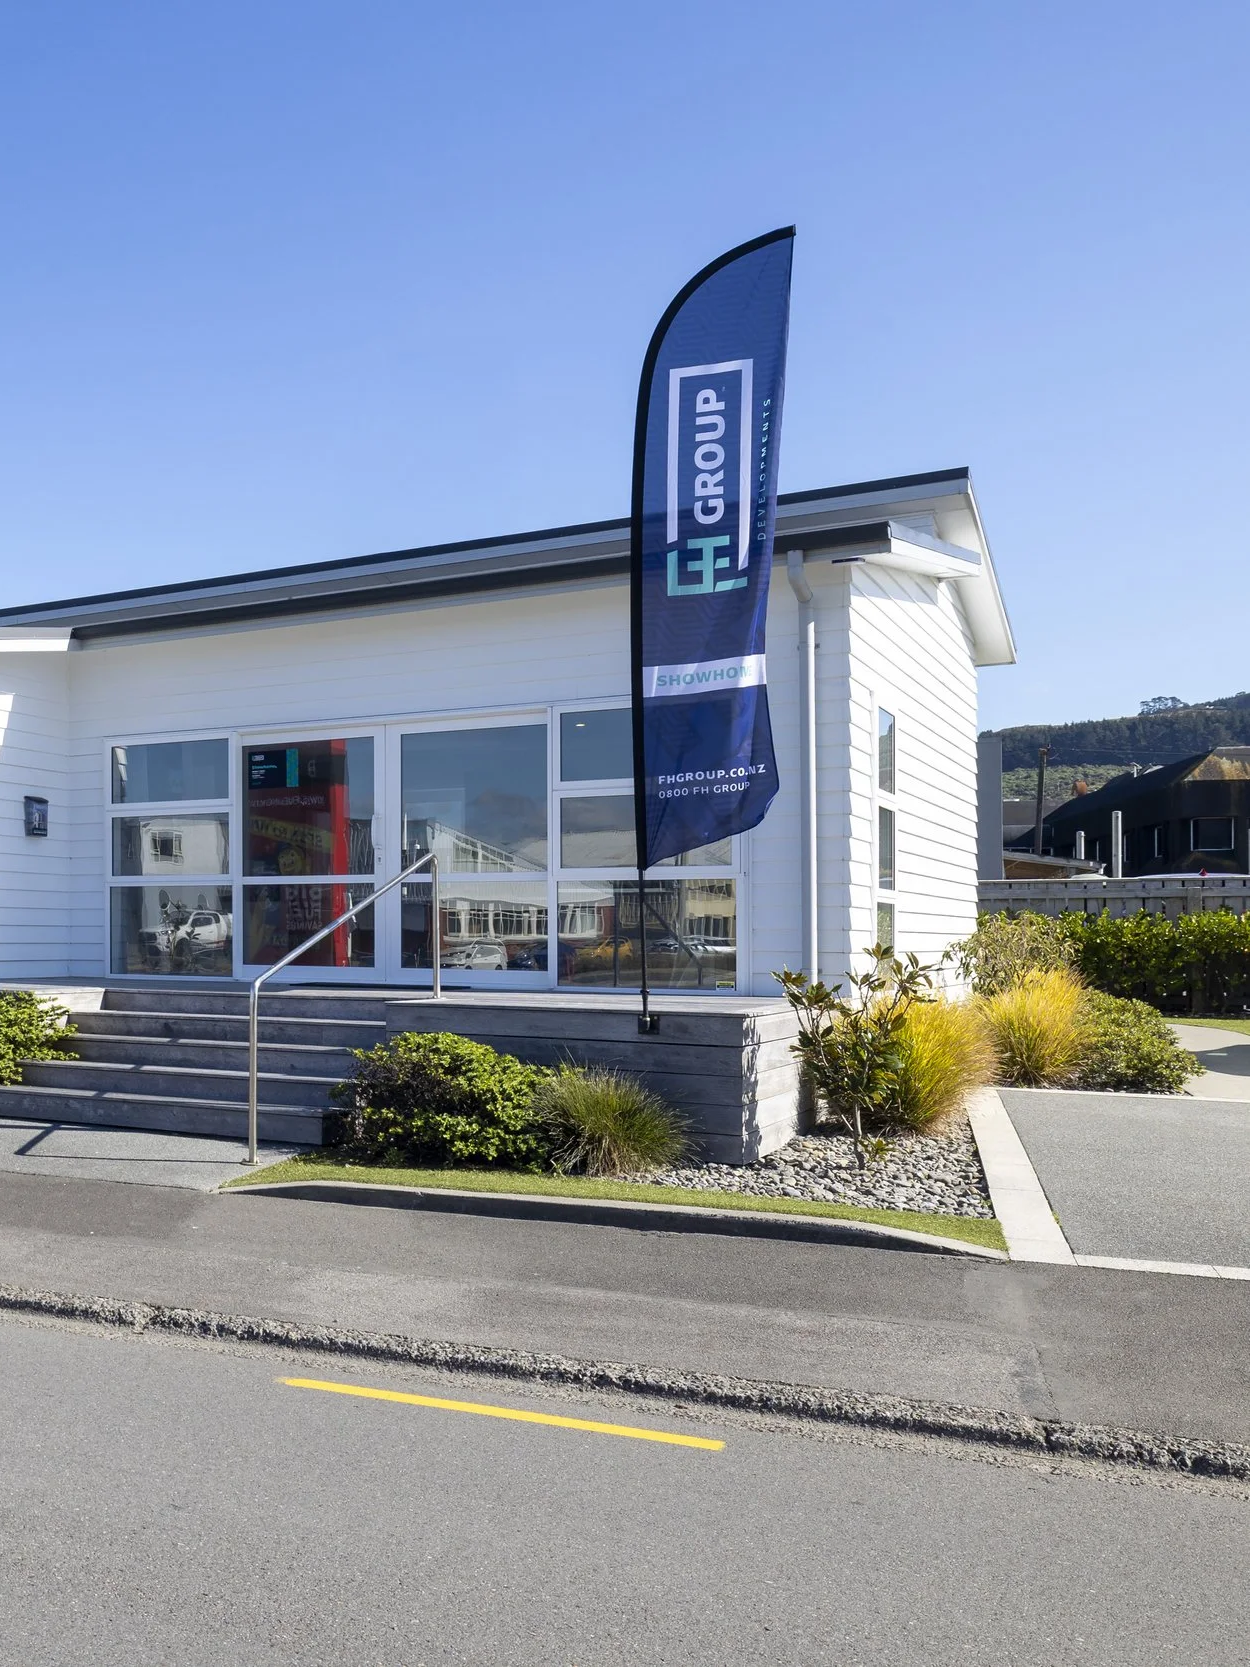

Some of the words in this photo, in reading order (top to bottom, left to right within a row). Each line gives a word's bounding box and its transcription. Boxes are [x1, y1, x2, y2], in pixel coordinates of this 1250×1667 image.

[693, 388, 726, 525] GROUP
[757, 398, 771, 541] DEVELOPMENTS
[656, 665, 752, 687] SHOWHOM
[658, 763, 766, 785] FHGROUP.CO.NZ
[658, 787, 689, 799] 0800
[693, 786, 709, 795] FH
[713, 781, 750, 794] GROUP
